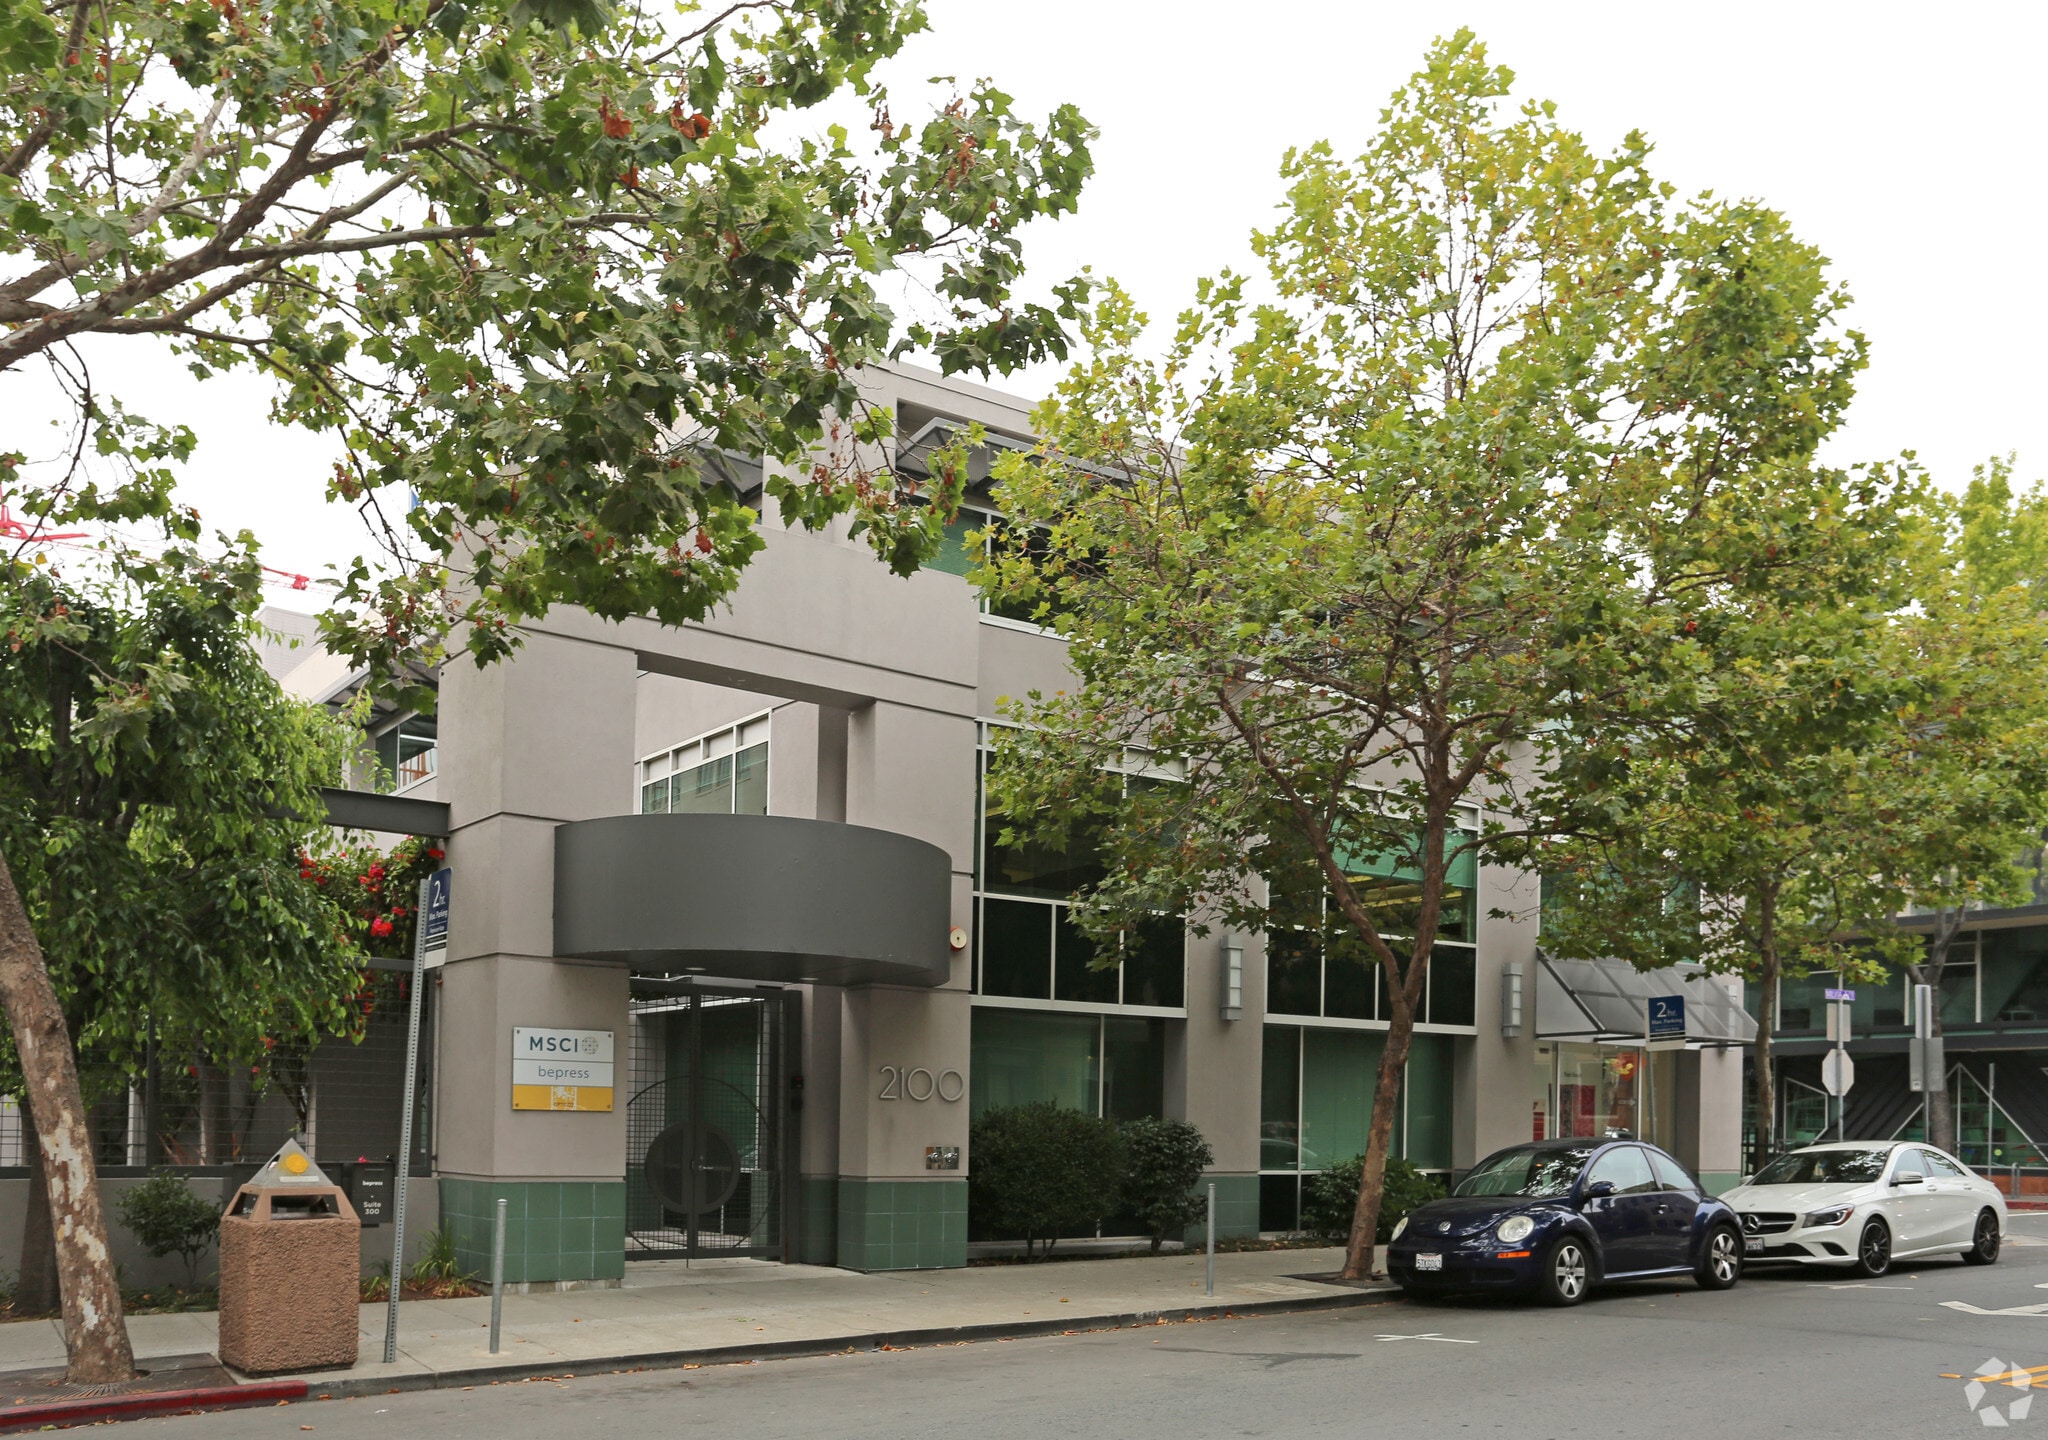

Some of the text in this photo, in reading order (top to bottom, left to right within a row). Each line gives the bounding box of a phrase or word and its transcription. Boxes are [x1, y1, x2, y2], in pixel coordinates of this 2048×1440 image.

[529, 1036, 578, 1053] MSCI
[538, 1065, 590, 1080] bepress
[880, 1065, 964, 1101] 2100
